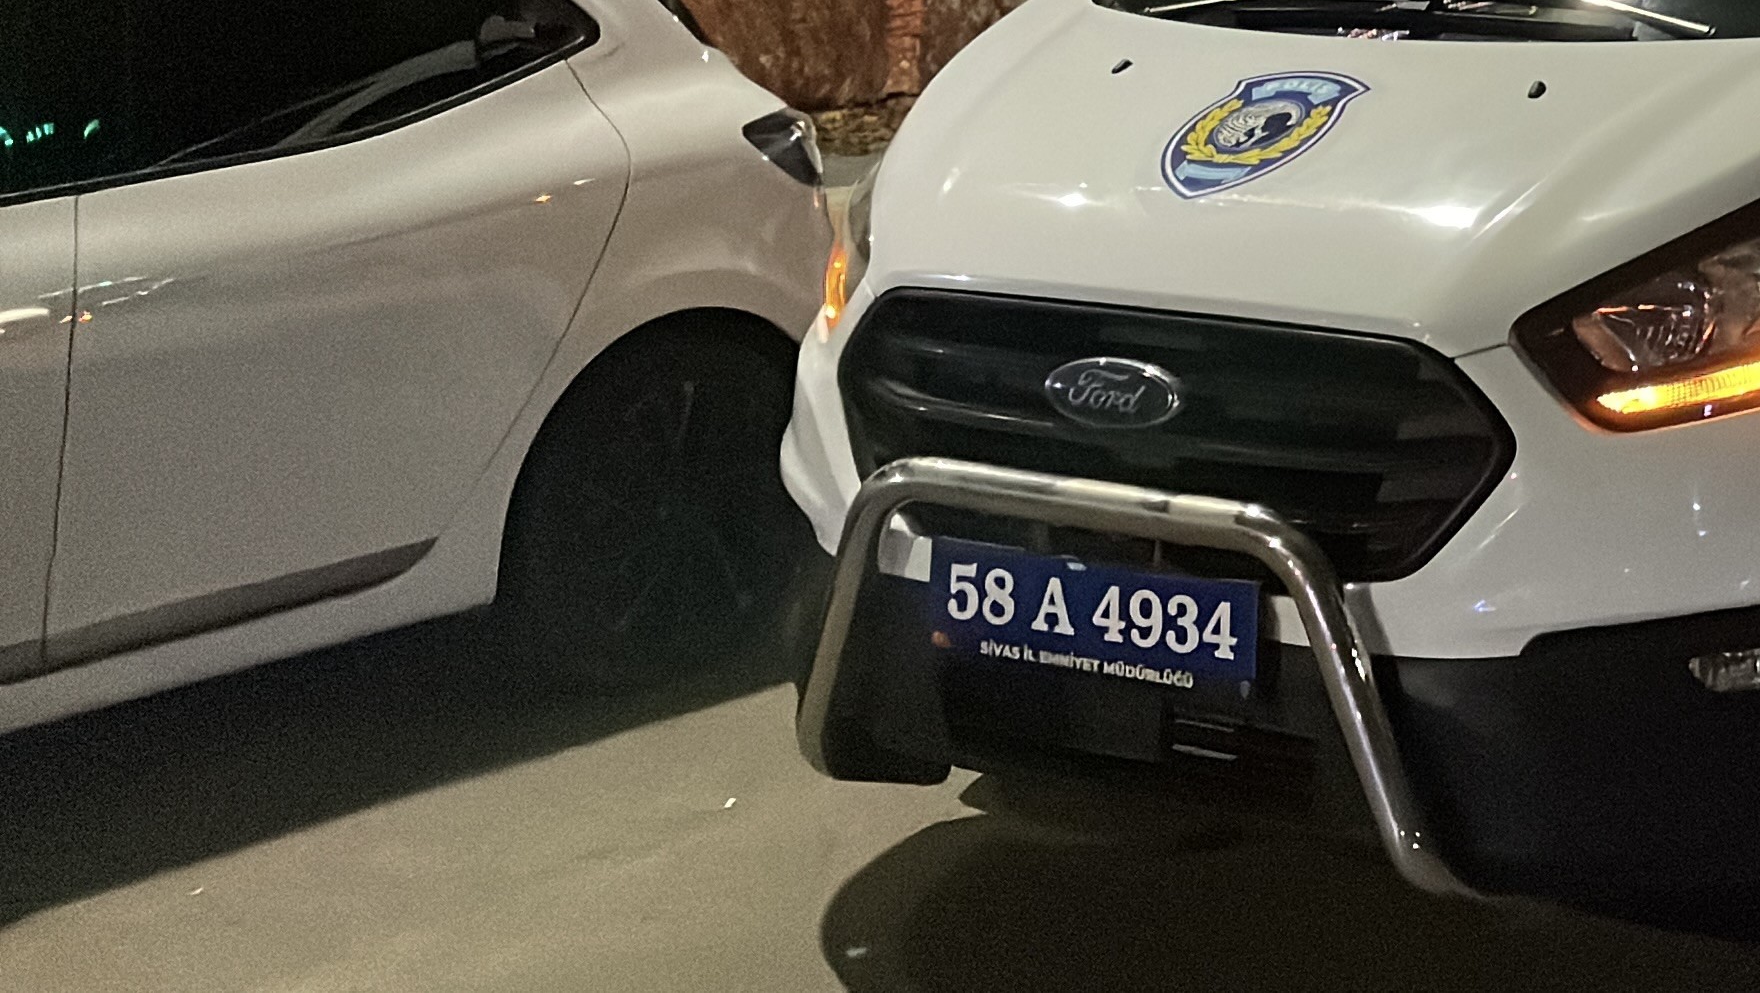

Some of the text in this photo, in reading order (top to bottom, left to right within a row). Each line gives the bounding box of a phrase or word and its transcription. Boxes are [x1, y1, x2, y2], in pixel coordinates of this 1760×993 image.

[1068, 368, 1147, 414] Ford
[947, 562, 1238, 660] 58 A 4934
[979, 638, 1021, 661] SİVAS
